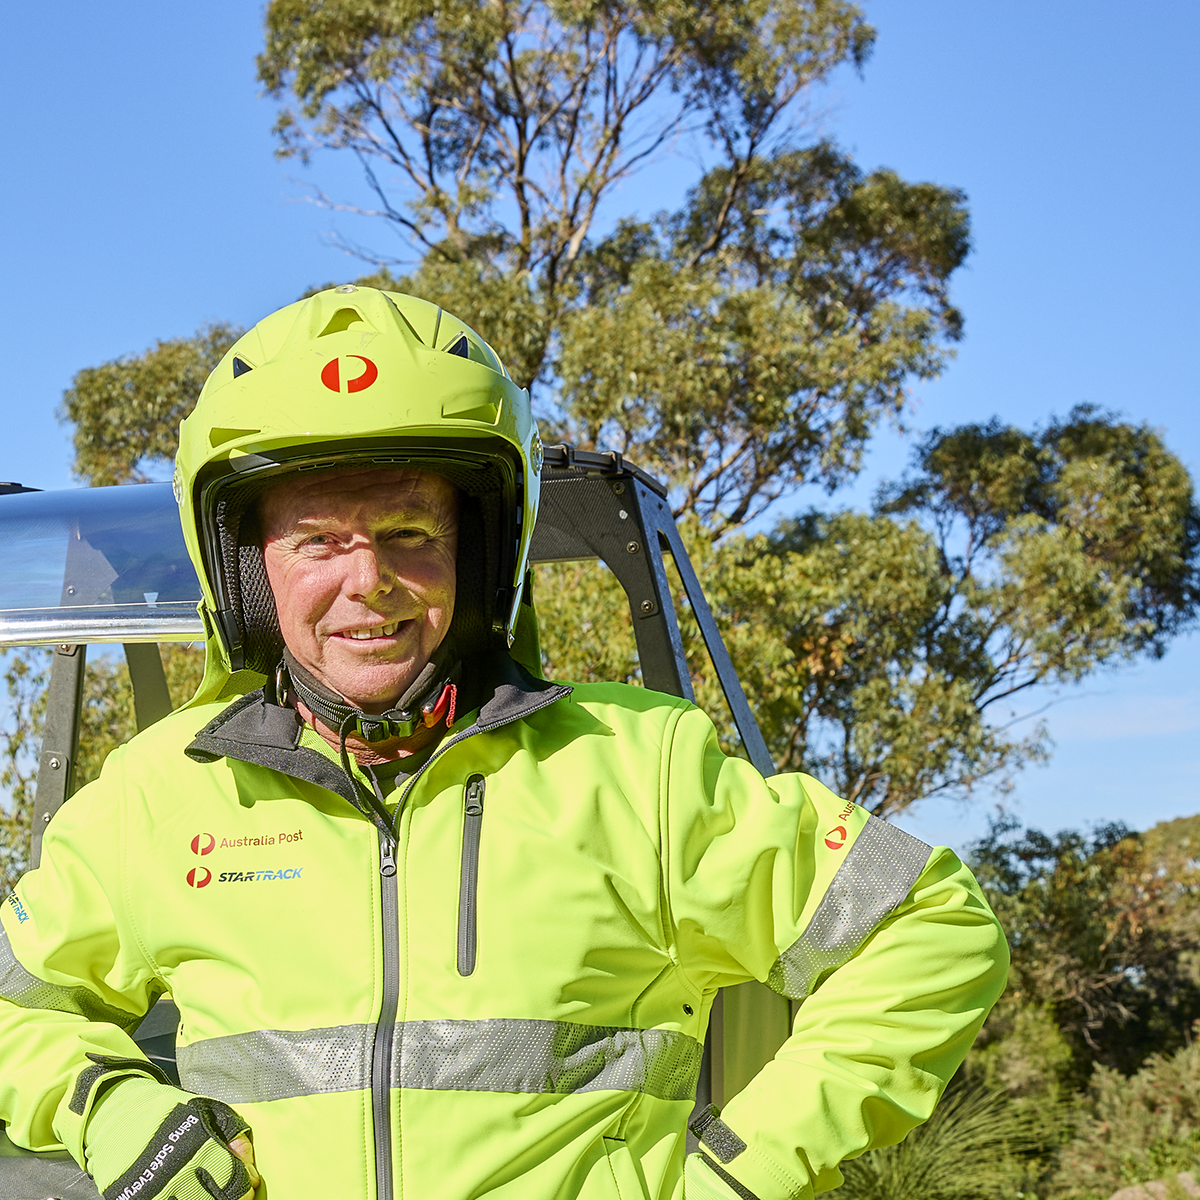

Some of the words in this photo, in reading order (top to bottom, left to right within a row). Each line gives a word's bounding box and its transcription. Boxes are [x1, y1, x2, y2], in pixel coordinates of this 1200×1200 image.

[220, 835, 275, 849] Australia
[278, 829, 303, 845] Post
[218, 867, 304, 883] STARTRACK
[168, 1114, 200, 1142] Being
[150, 1143, 174, 1170] Safe
